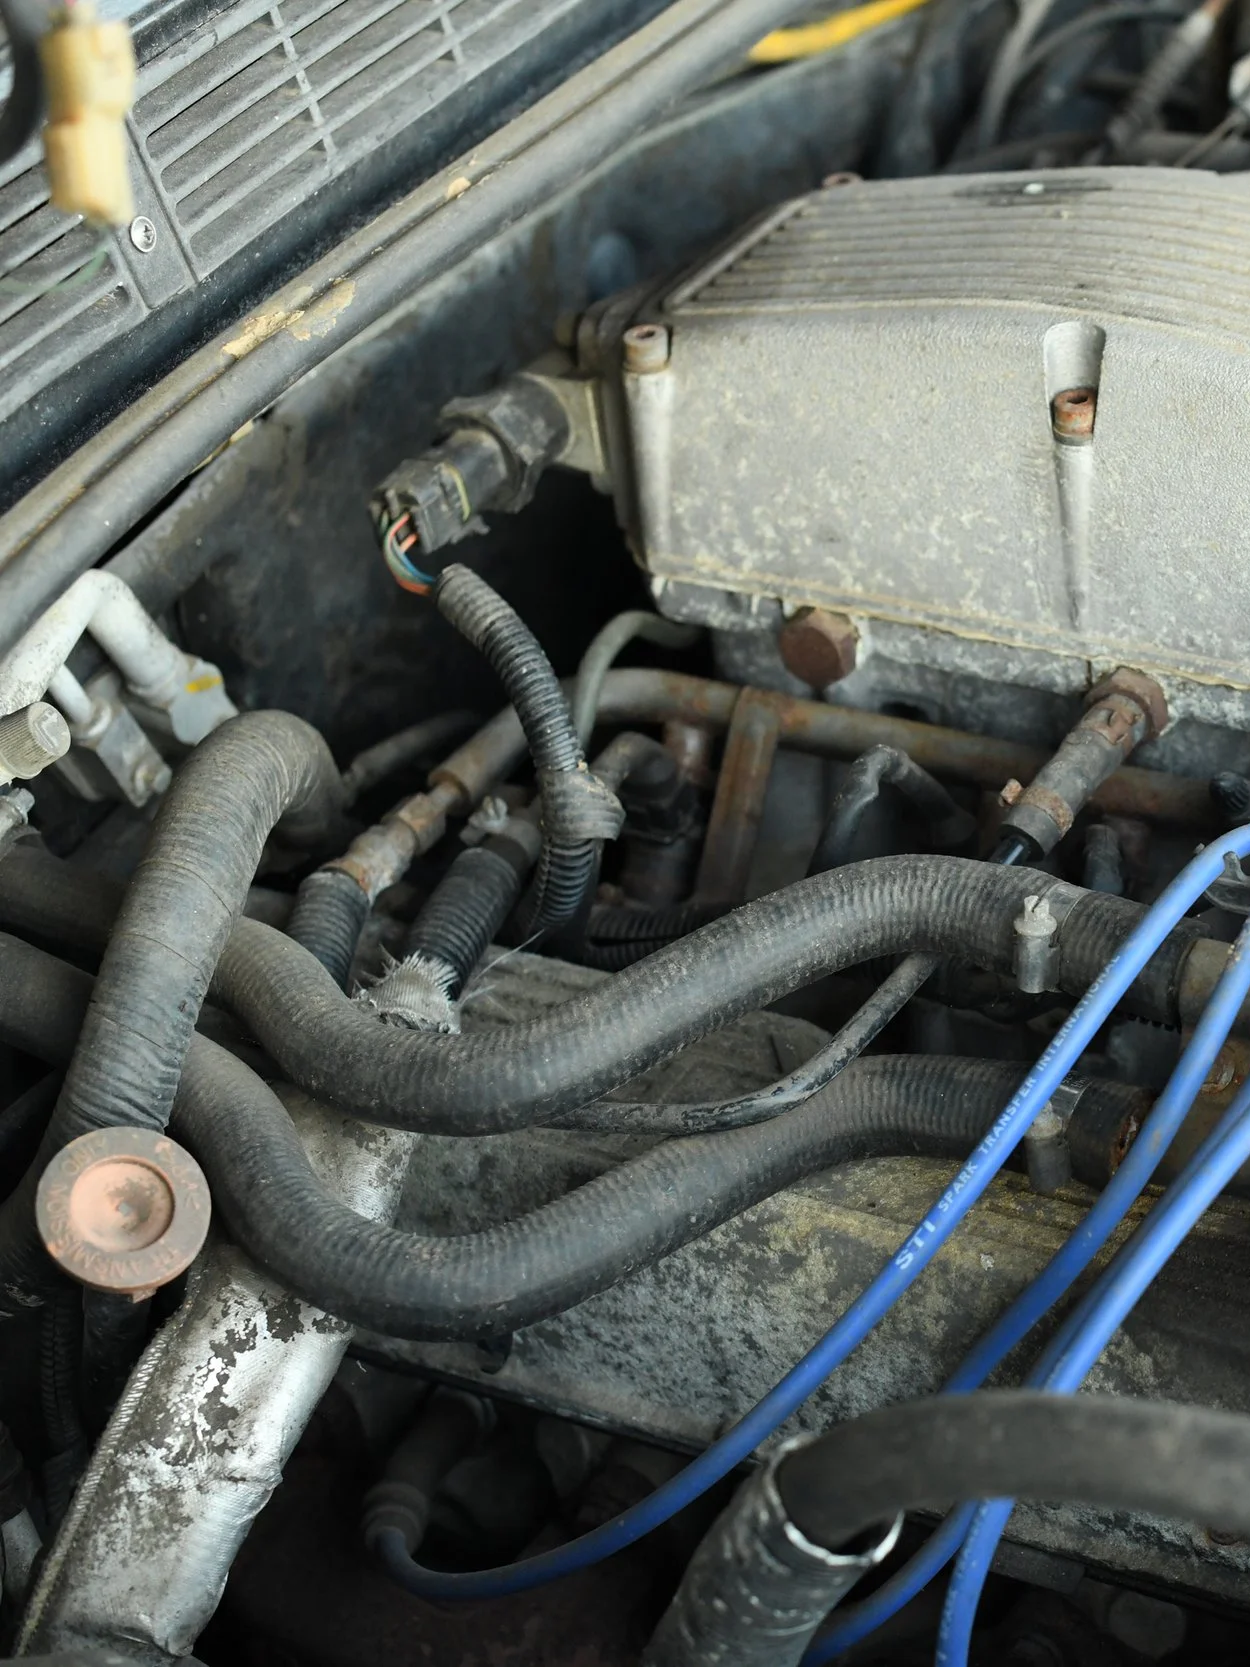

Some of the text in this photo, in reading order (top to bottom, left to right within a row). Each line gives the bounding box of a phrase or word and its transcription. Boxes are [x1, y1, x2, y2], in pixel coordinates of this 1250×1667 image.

[895, 1220, 936, 1270] STI
[938, 1163, 978, 1212] SPARK
[978, 1076, 1036, 1156] TRANSFER
[1037, 954, 1121, 1073] INTERNATIONAL
